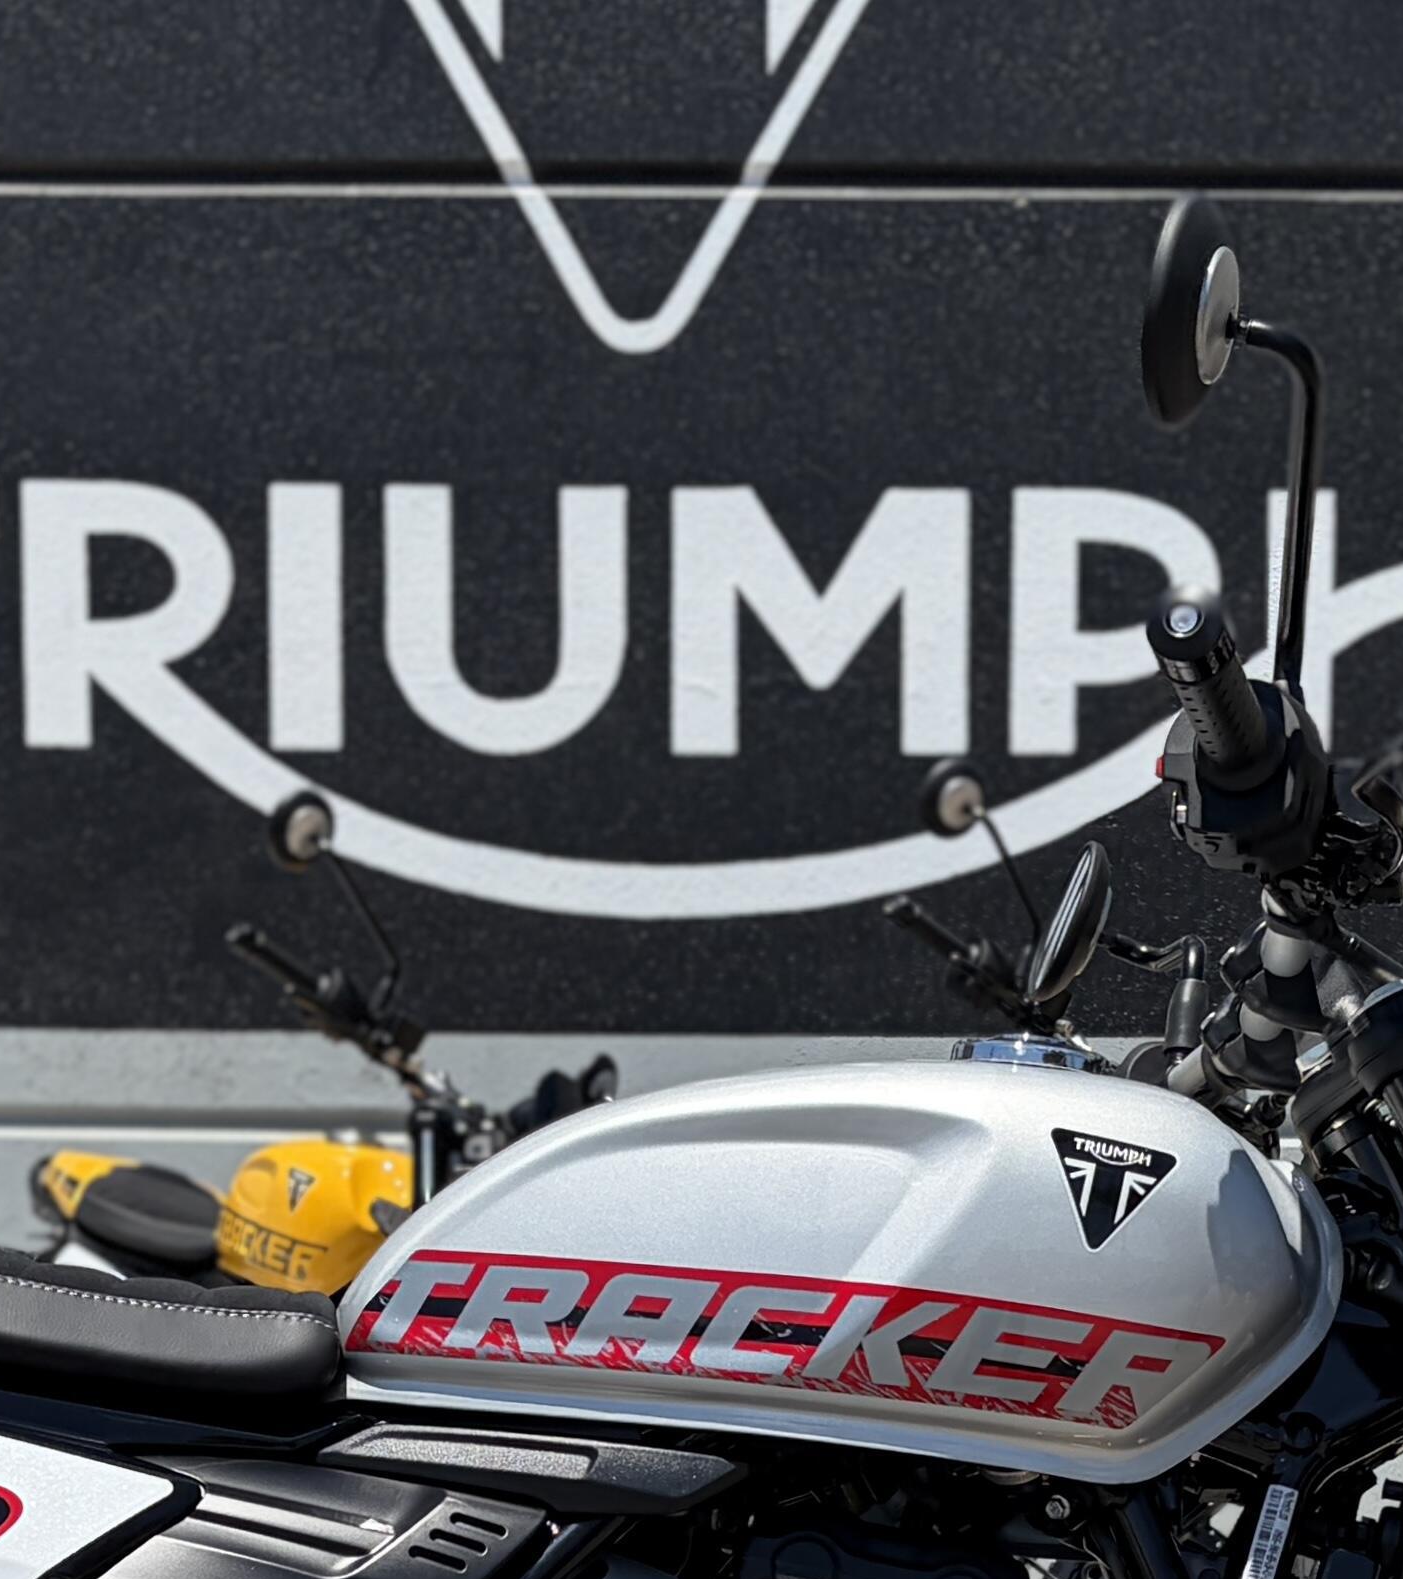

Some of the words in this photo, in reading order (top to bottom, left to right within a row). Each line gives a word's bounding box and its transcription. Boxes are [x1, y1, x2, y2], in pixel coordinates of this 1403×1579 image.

[1073, 1136, 1153, 1168] TRIUMPH
[217, 1209, 318, 1282] RACKER
[369, 1258, 1214, 1424] TRACKER
